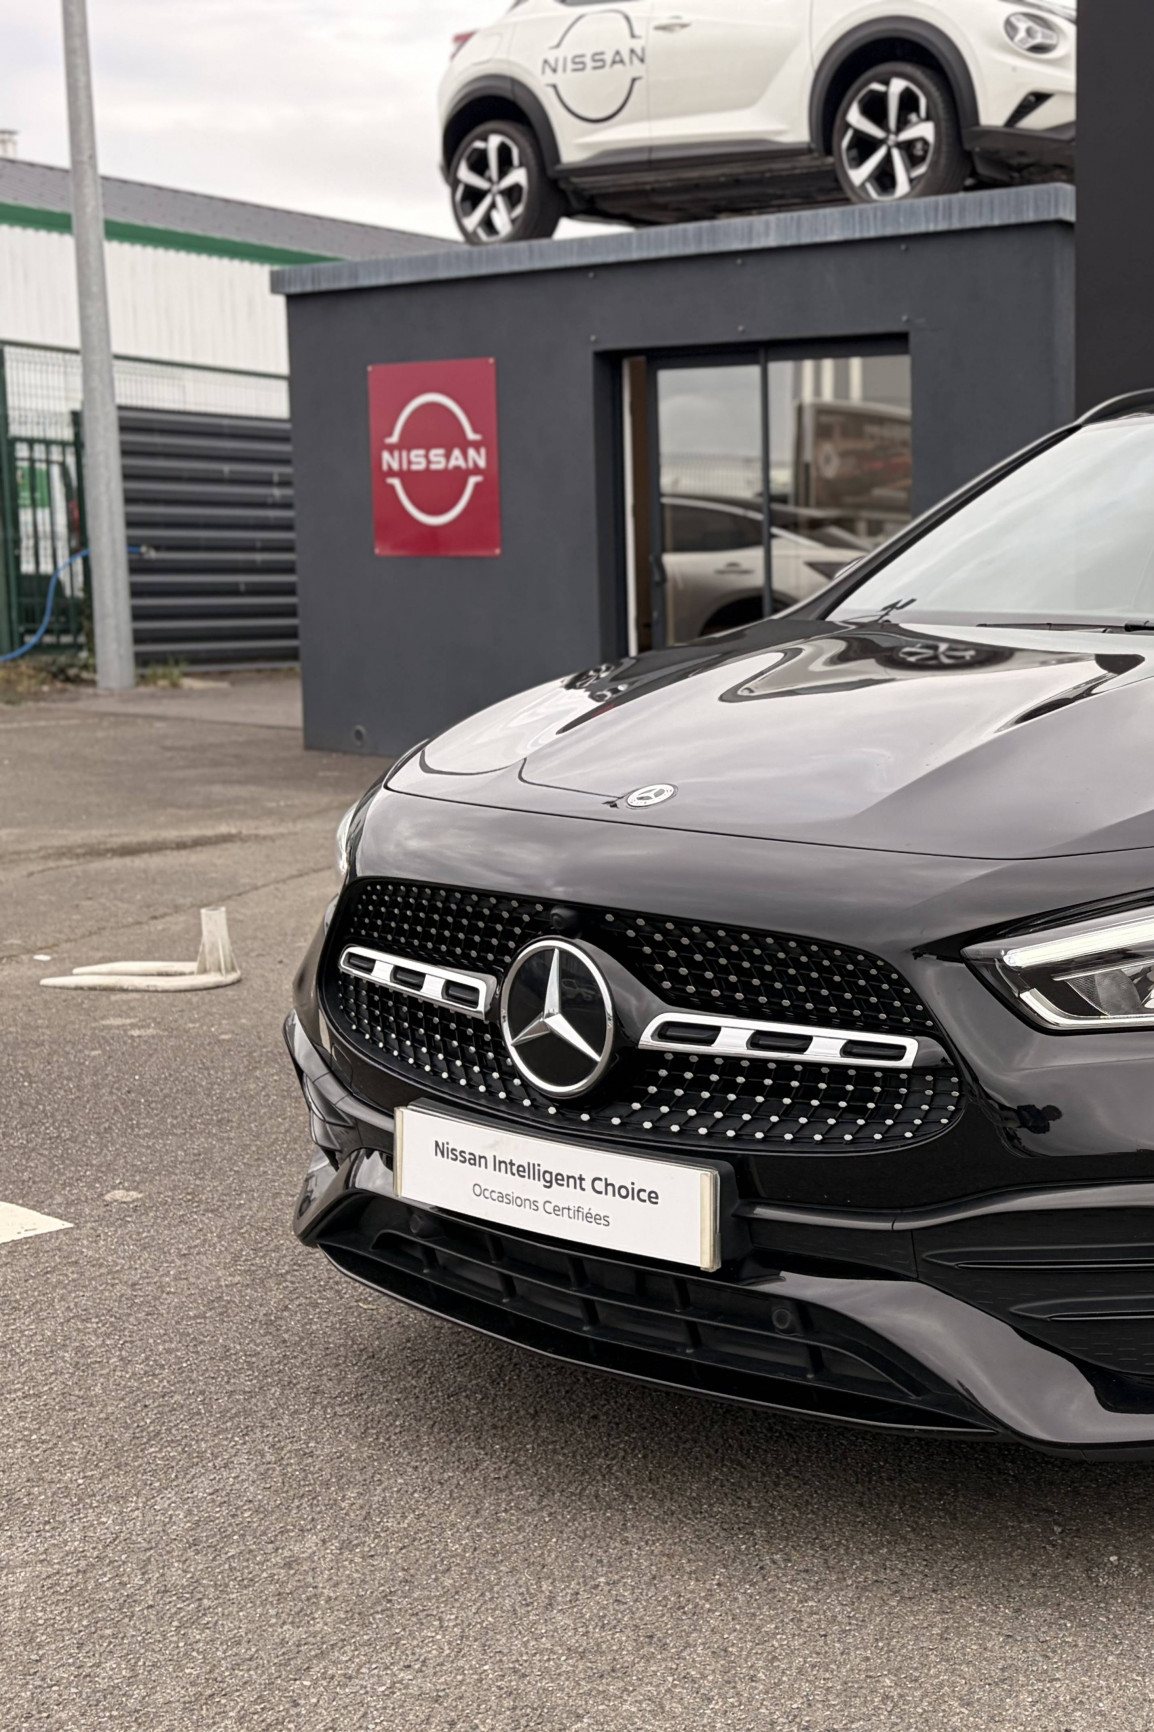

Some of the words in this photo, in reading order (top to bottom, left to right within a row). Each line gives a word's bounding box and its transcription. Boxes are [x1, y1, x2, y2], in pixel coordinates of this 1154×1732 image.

[541, 45, 646, 75] NISSAN
[381, 446, 487, 472] NISSAN
[433, 1139, 489, 1170] Nissan
[492, 1154, 586, 1193] Intelligent
[590, 1176, 660, 1205] Choice
[472, 1183, 540, 1212] Occasions
[542, 1199, 611, 1227] Certifiées
